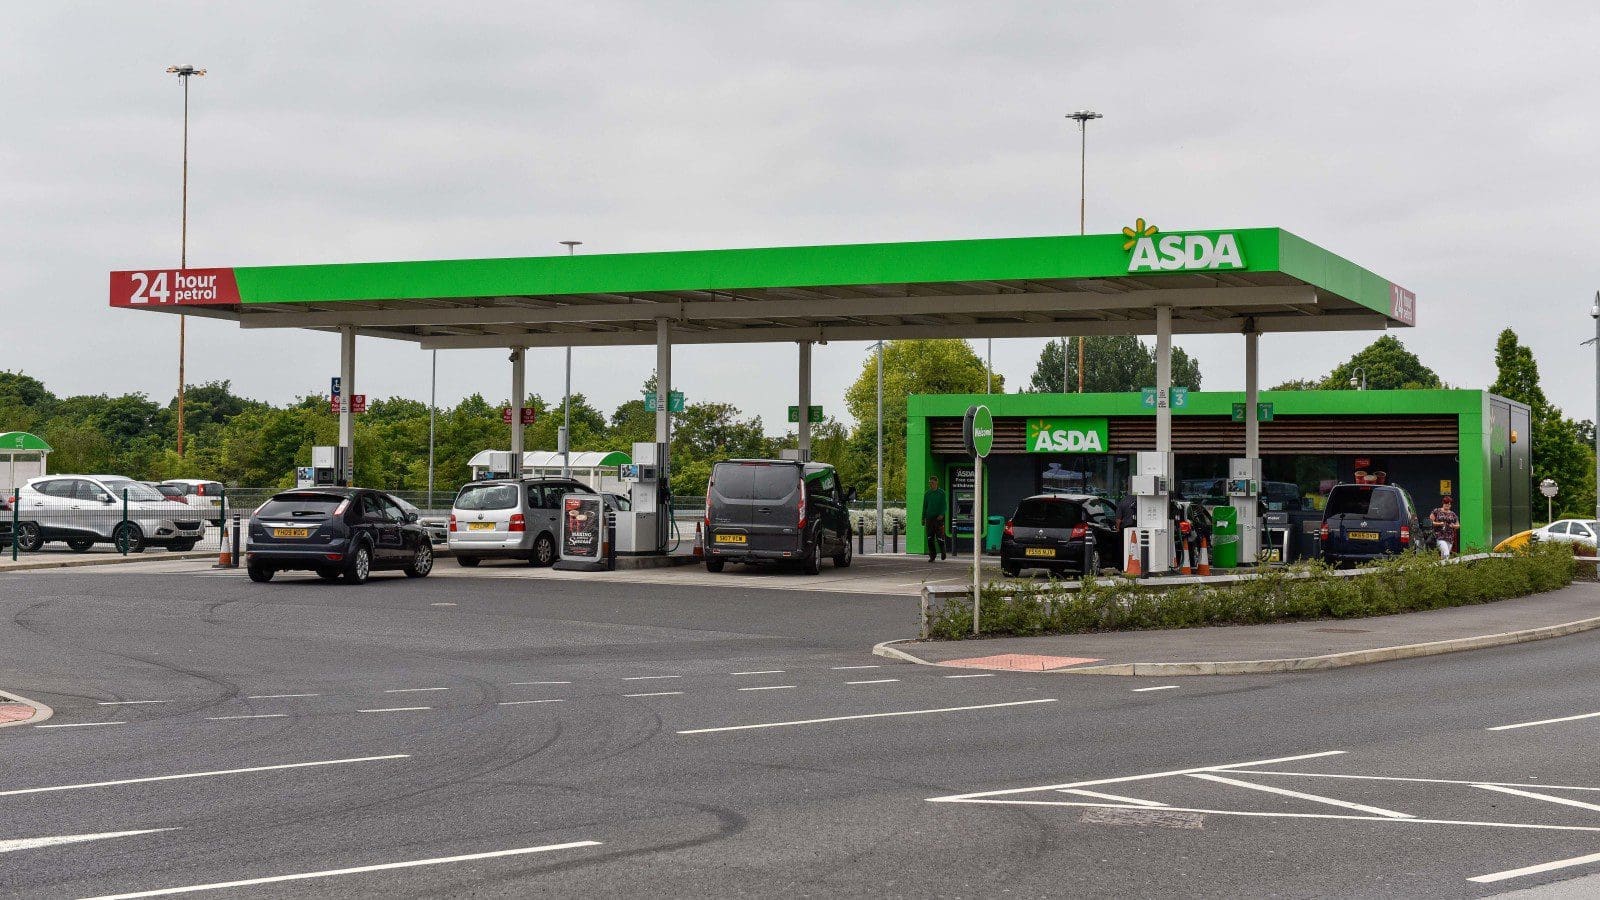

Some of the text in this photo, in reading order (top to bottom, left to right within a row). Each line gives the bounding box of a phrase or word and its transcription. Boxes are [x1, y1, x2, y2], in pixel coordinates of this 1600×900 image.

[1128, 234, 1242, 271] ASDA
[130, 272, 216, 303] 24 hour
[174, 286, 216, 303] petrol
[1394, 286, 1403, 319] 24
[649, 399, 656, 409] 8
[672, 398, 680, 409] 7
[1145, 394, 1155, 405] 4
[1175, 393, 1184, 405] 3
[1236, 409, 1244, 418] 2
[1263, 408, 1269, 418] 1
[1034, 430, 1102, 451] ASDA
